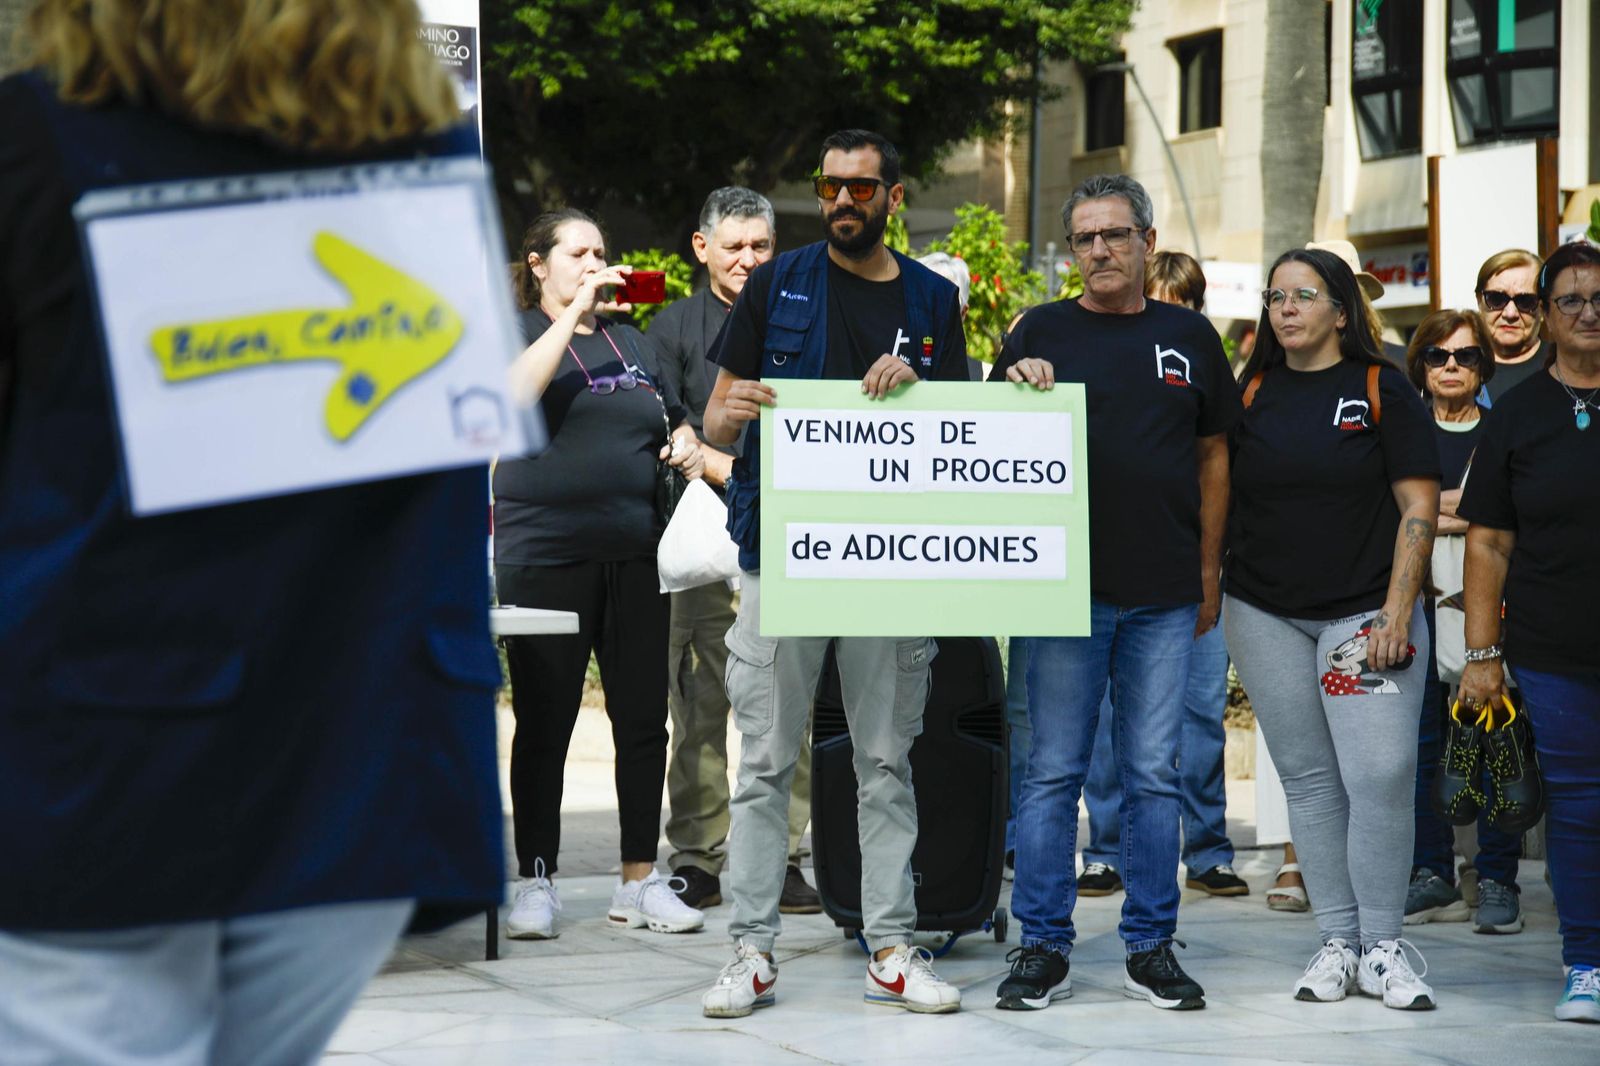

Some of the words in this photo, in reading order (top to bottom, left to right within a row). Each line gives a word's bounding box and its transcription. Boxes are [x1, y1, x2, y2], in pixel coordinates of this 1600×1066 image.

[784, 419, 915, 445] VENIMOS
[940, 421, 977, 445] DE
[869, 458, 909, 483] UN
[932, 458, 1067, 484] PROCESO
[791, 533, 832, 560] de
[841, 534, 1039, 563] ADICCIONES
